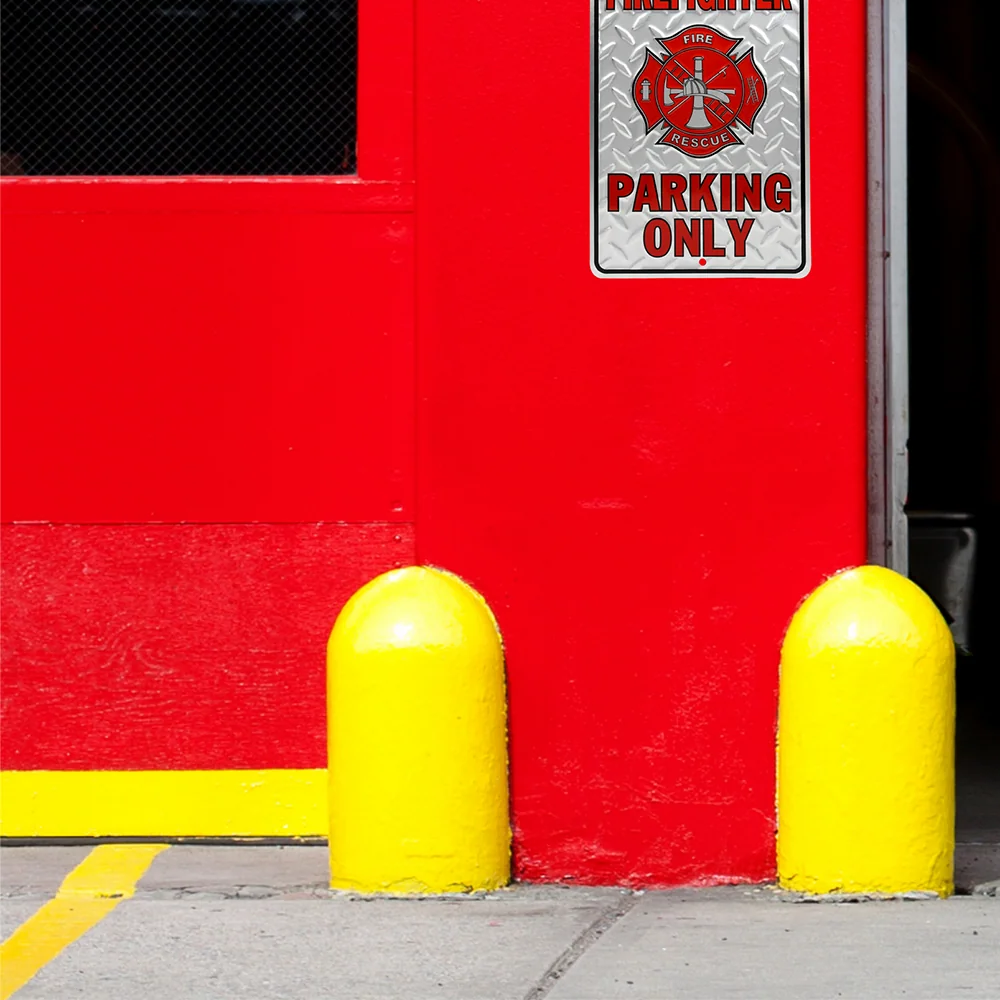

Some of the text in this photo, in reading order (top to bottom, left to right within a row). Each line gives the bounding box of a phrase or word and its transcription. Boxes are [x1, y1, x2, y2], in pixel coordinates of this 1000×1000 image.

[683, 33, 713, 45] FIRE
[671, 132, 730, 148] RESCUE
[607, 172, 792, 213] PARKING
[642, 217, 756, 258] ONLY
